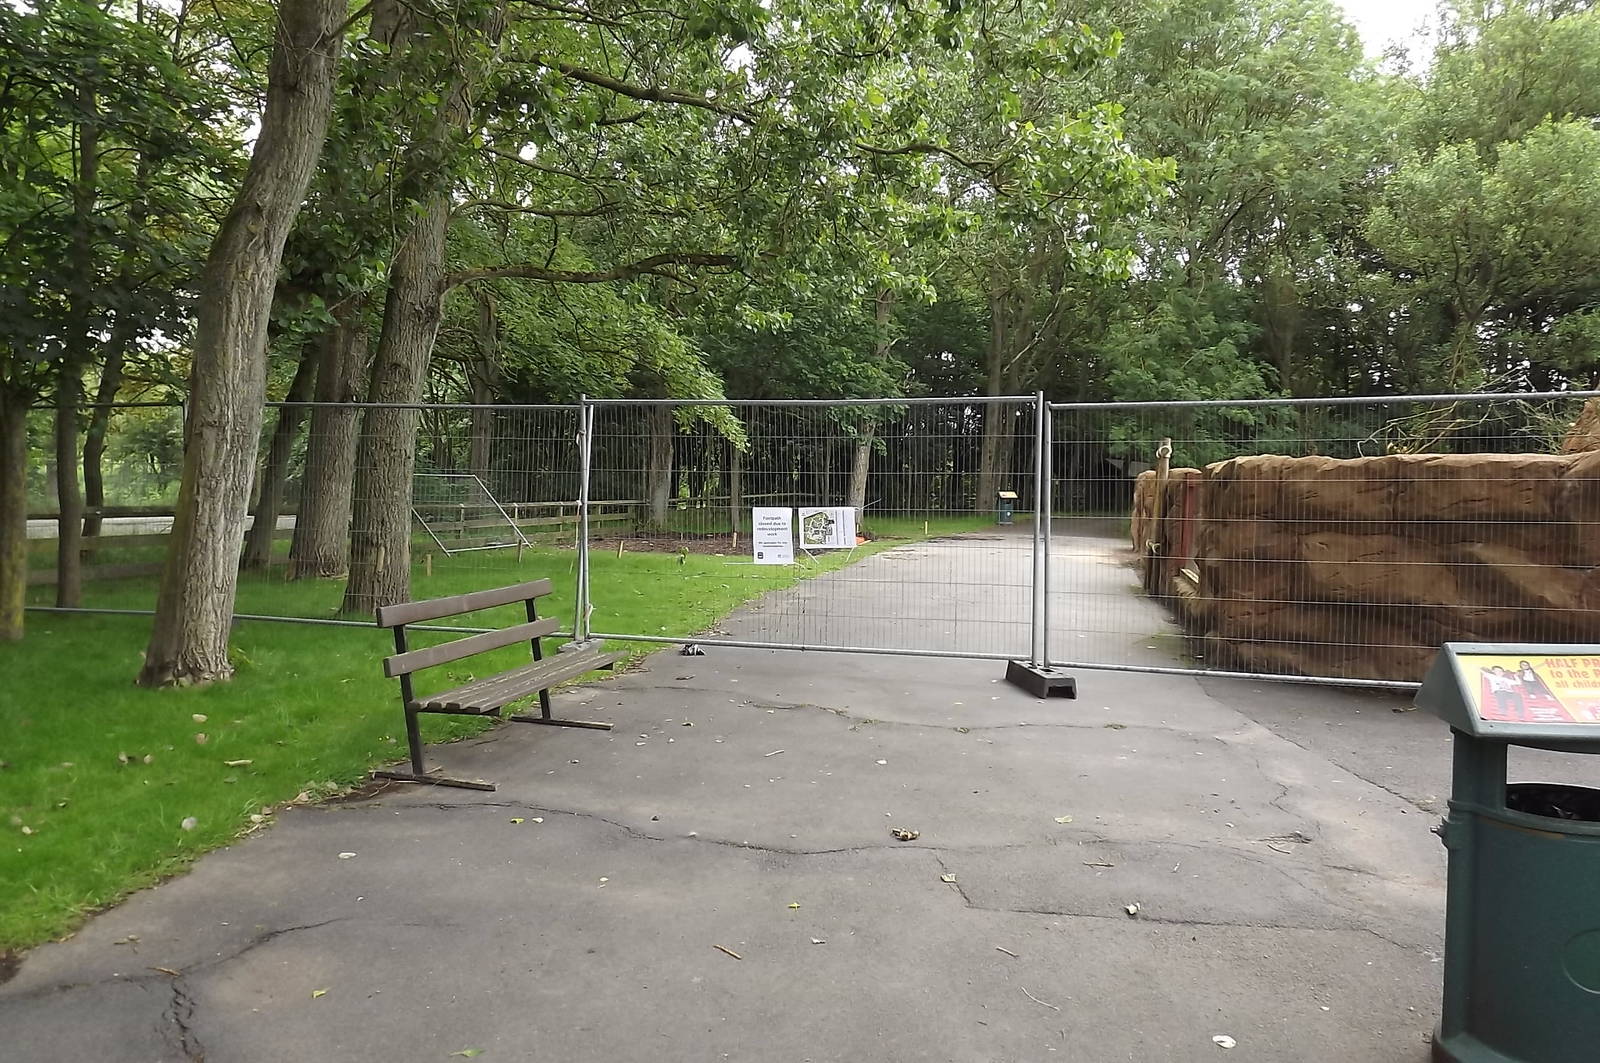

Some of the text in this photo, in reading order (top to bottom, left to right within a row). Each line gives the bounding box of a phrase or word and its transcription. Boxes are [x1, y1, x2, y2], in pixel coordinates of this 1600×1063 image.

[1545, 658, 1577, 668] HALF
[1550, 669, 1563, 679] to
[1568, 668, 1590, 679] the
[1555, 680, 1569, 688] all
